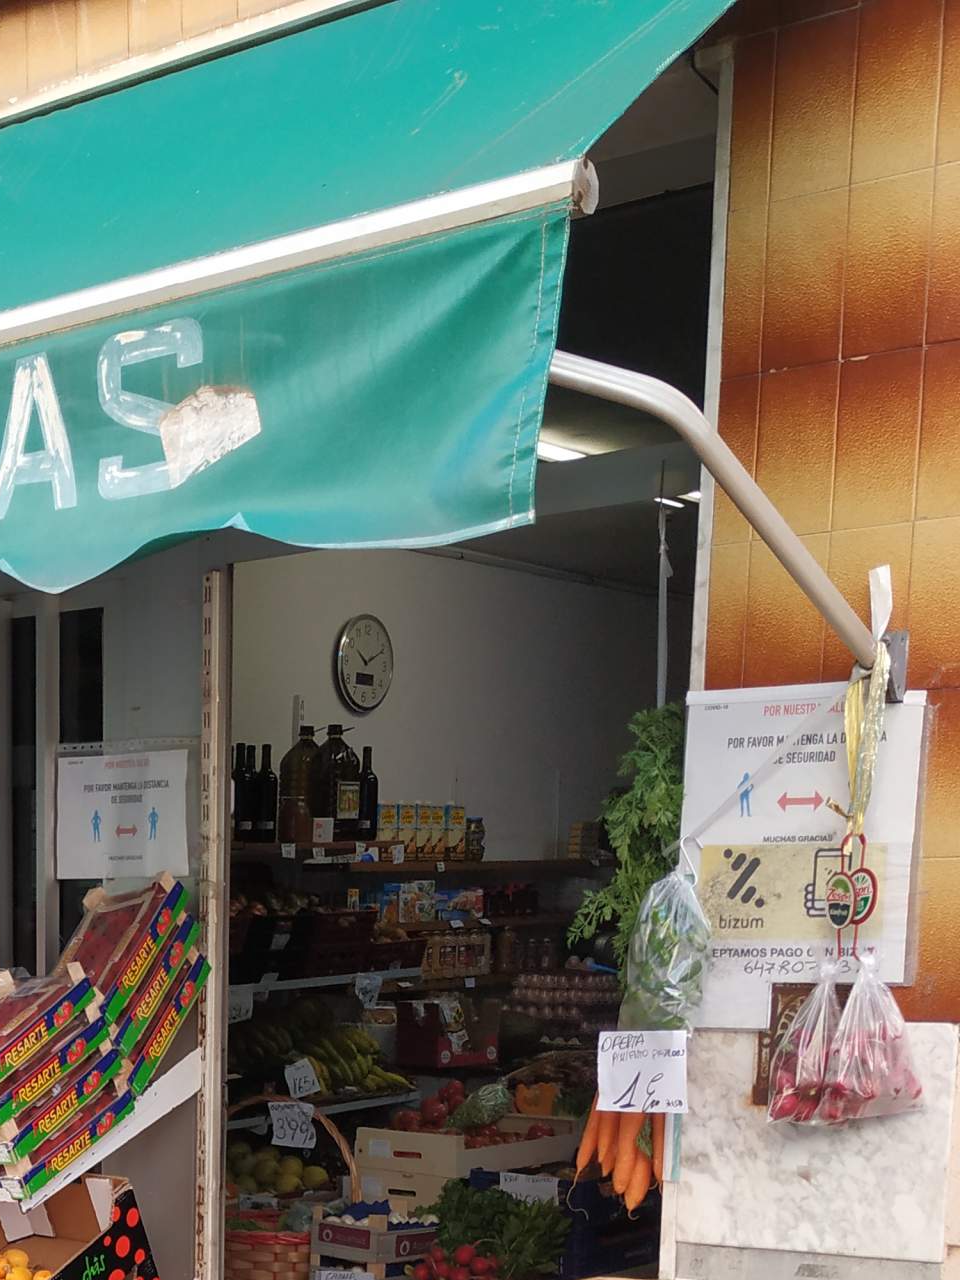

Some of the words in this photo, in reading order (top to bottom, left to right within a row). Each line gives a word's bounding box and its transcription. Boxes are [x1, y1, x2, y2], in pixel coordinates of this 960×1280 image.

[763, 705, 781, 717] POR
[783, 703, 821, 716] NUESTR
[727, 737, 744, 749] POR
[747, 735, 774, 748] FAVOR
[826, 732, 838, 743] LA
[786, 751, 836, 764] SEGURIDAD
[797, 834, 833, 842] GRACIAS
[719, 915, 764, 929] bizum
[770, 946, 803, 958] PAGO
[805, 947, 833, 957] CN
[117, 934, 158, 996] FRESARTE
[130, 967, 169, 1029] FRESARTE
[145, 1005, 180, 1068] FRESARTE
[601, 1033, 645, 1053] OFERTA
[12, 1058, 61, 1108] FRESARTE
[31, 1088, 78, 1138] FRESARTE
[44, 1129, 92, 1177] FRESARTE
